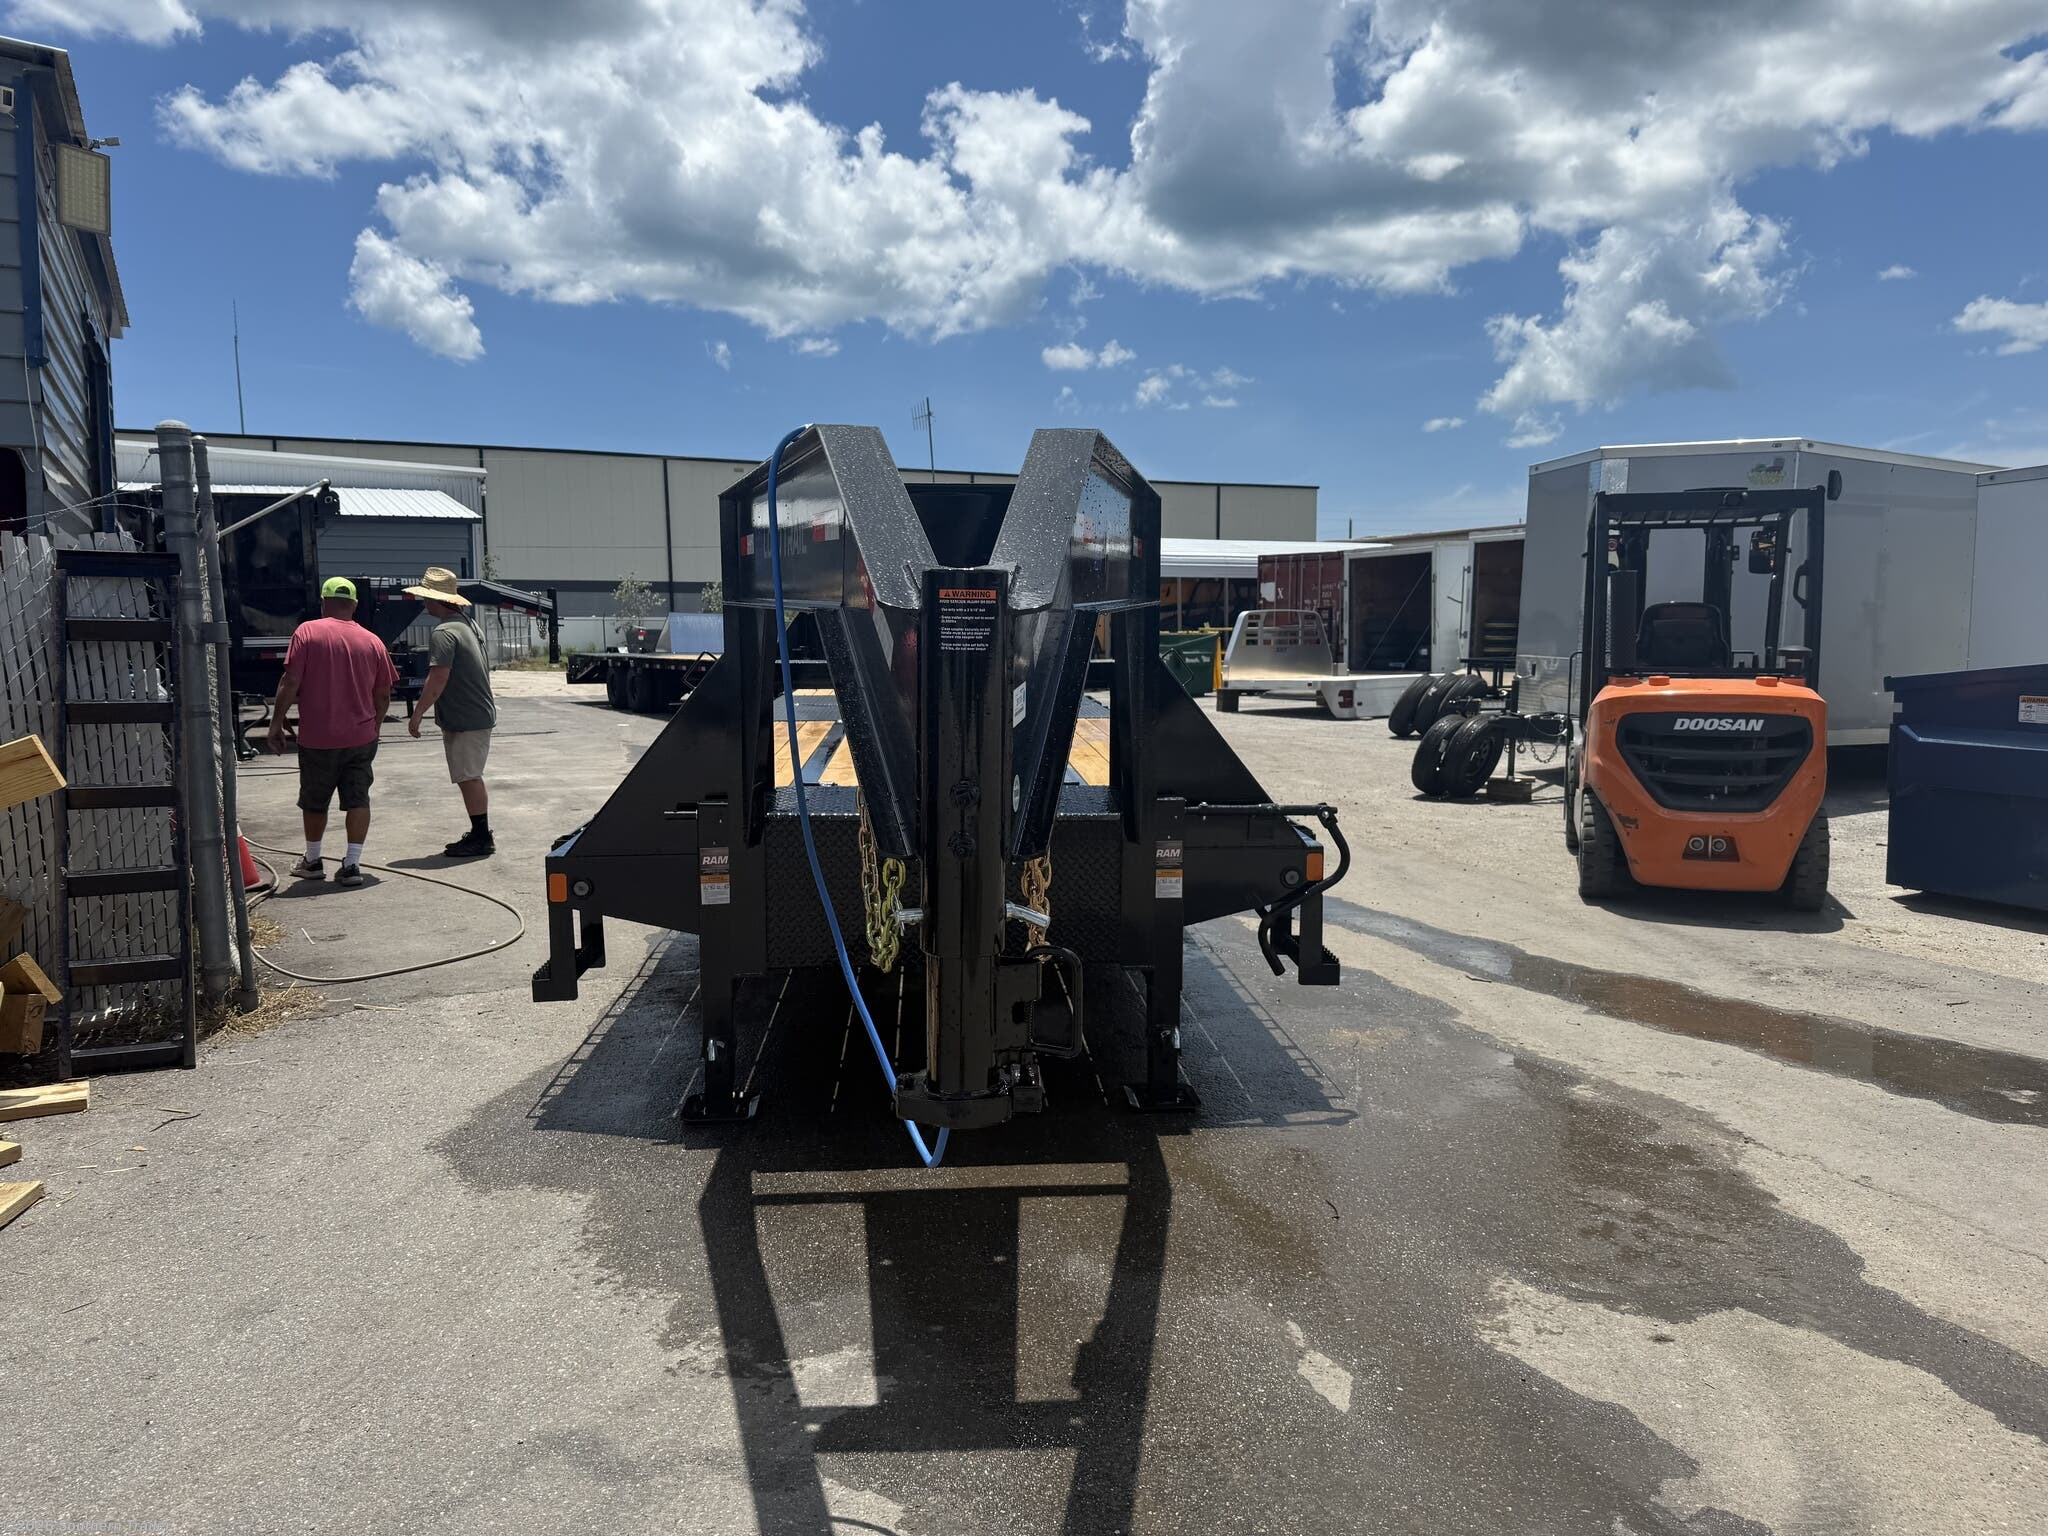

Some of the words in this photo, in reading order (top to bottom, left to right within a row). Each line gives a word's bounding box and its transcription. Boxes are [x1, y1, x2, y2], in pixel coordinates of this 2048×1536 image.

[390, 577, 422, 585] U-DUM
[952, 590, 991, 598] WARNING
[1673, 718, 1764, 731] DOOSAN
[1155, 849, 1181, 857] RAM
[702, 856, 728, 864] RAM
